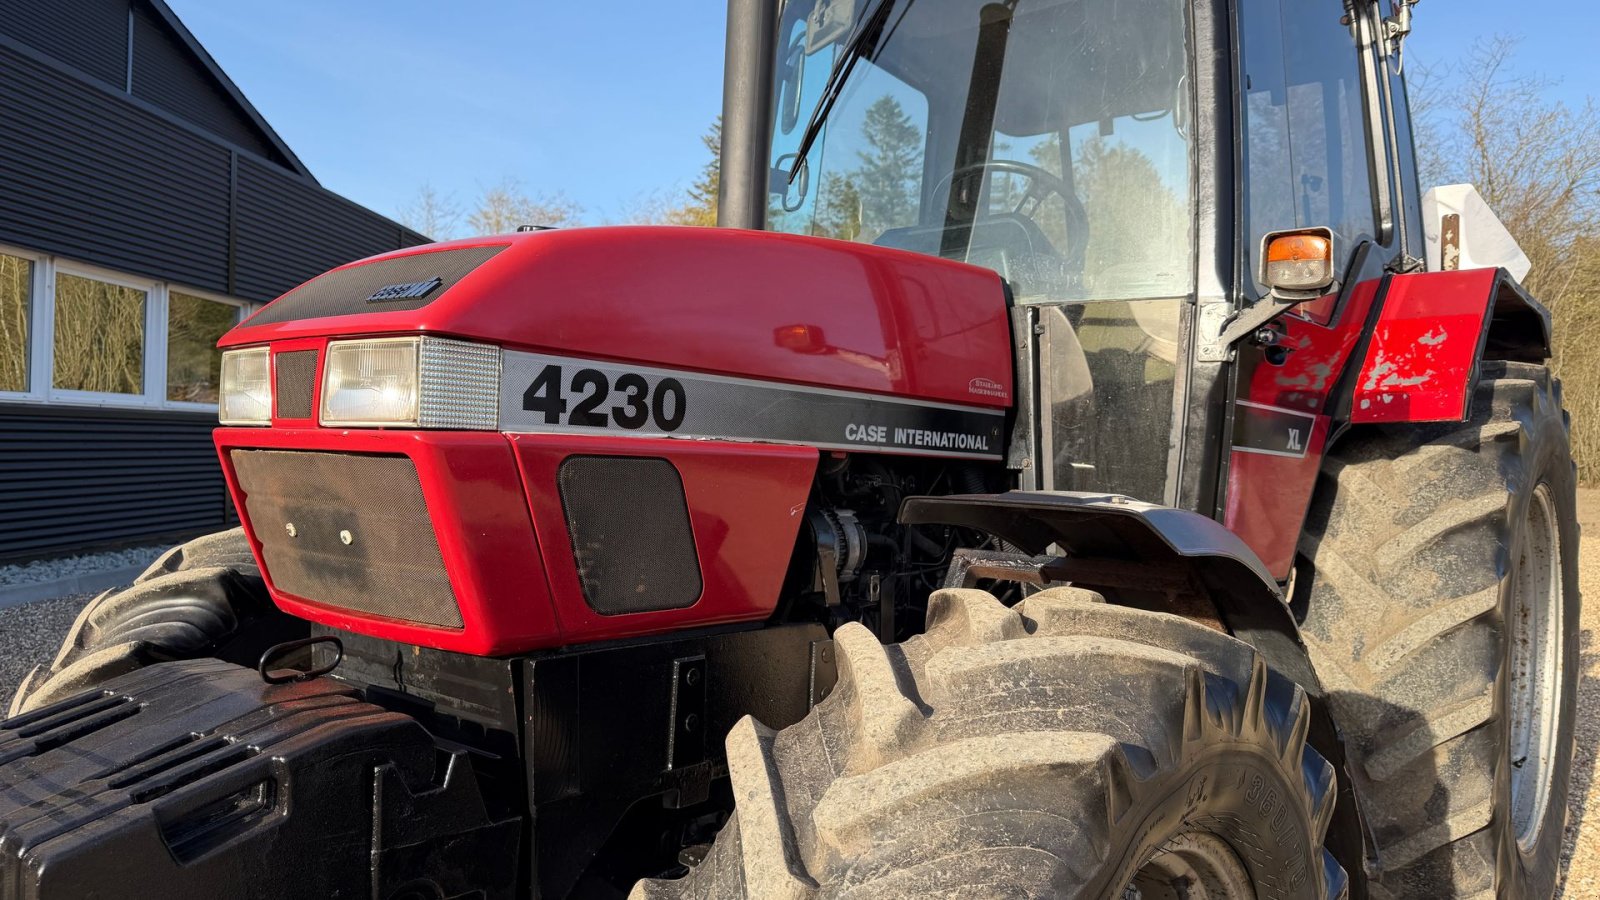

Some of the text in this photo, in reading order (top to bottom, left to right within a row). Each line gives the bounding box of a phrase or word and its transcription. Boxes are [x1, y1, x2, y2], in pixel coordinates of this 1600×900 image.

[522, 364, 687, 432] 4230
[845, 423, 989, 450] CASE INTERNATIONAL
[1286, 428, 1301, 450] XL
